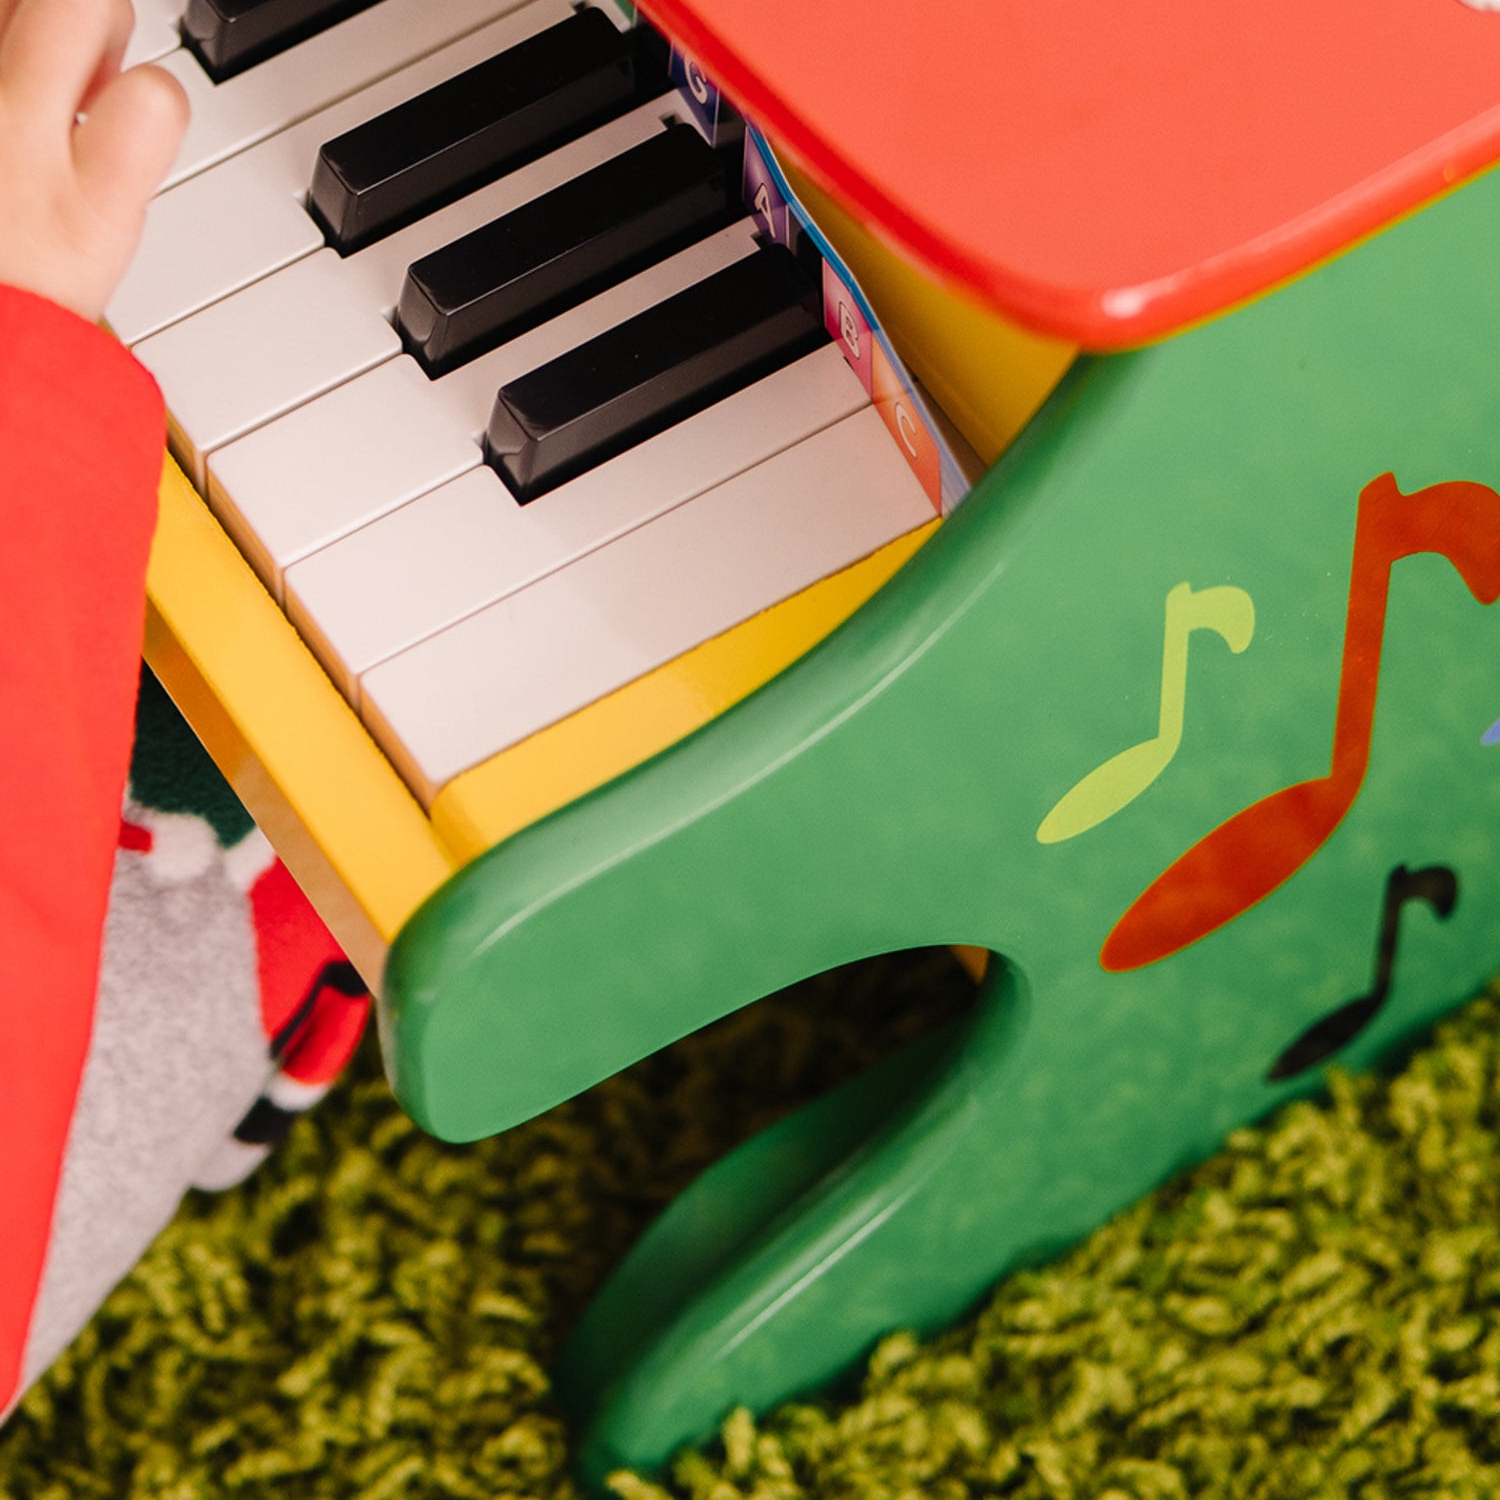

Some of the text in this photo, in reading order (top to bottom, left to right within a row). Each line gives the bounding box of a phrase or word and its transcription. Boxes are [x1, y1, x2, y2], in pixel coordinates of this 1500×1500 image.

[684, 53, 918, 460] G A B C
